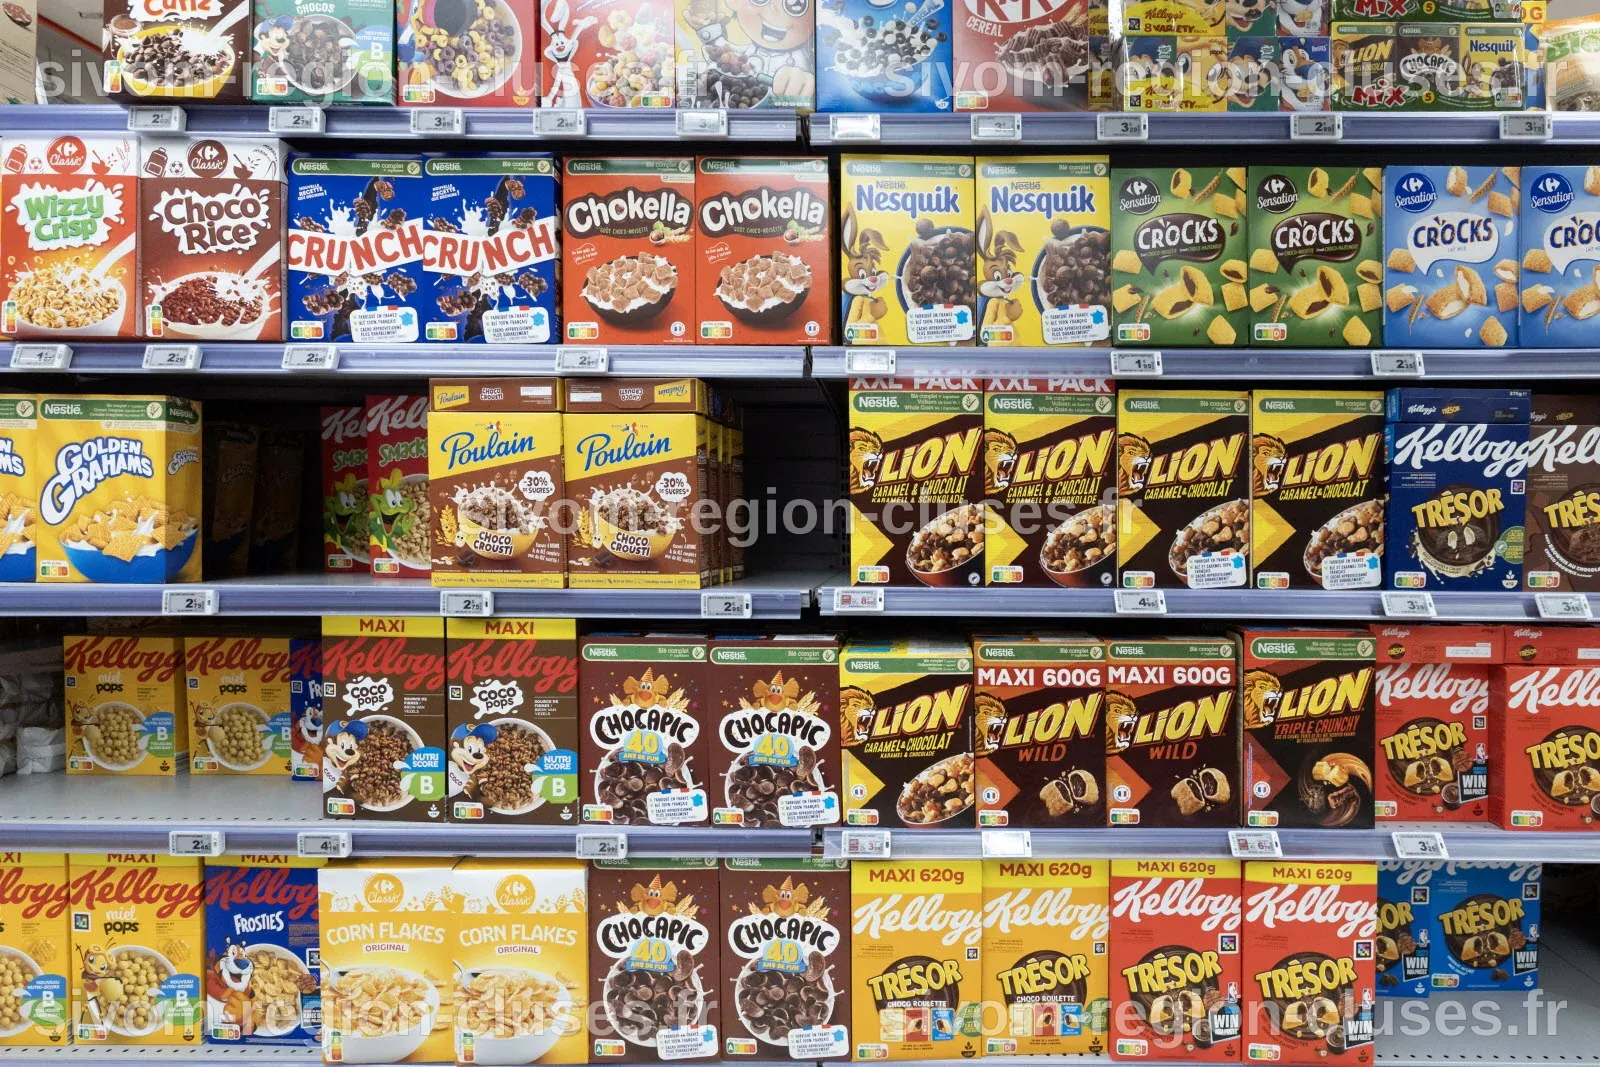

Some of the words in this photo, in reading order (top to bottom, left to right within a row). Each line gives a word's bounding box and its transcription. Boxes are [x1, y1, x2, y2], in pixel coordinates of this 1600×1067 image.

[296, 2, 335, 15] CHOCOS
[1425, 3, 1433, 13] 5
[965, 15, 1003, 37] CEREAL
[1144, 23, 1152, 32] 8
[1153, 23, 1195, 33] VARIETY
[1349, 40, 1394, 63] LION
[1469, 40, 1517, 55] Nesquik
[24, 194, 105, 220] Wizzy
[856, 184, 961, 219] Nesquik
[991, 185, 1096, 220] Nesquik
[1119, 194, 1161, 211] Sensation
[1256, 192, 1299, 210] Sensation
[1394, 191, 1437, 209] Sensation
[1530, 191, 1574, 209] Sensation
[164, 196, 261, 225] Choco
[568, 189, 690, 232] Chokella
[702, 189, 824, 232] Chokella
[35, 217, 98, 242] Crisp
[183, 221, 252, 252] Rice
[289, 224, 423, 274] CRUNCH
[423, 223, 554, 271] CRUNCH
[852, 370, 904, 390] XXL
[913, 370, 979, 390] PACK
[436, 391, 466, 405] Poulain
[479, 393, 504, 401] CROUSTI
[481, 387, 501, 395] CHOCO
[619, 388, 644, 396] CROUSTI
[45, 403, 83, 415] Nestlé
[859, 396, 900, 408] Nestlé
[1408, 405, 1437, 414] Kellogg's
[57, 437, 142, 480] GOLDEN
[440, 431, 536, 470] Poulain
[576, 433, 672, 472] Poulain
[878, 427, 982, 483] LION
[1013, 428, 1114, 483] LION
[1149, 433, 1243, 486] LION
[1284, 433, 1379, 486] LION
[1394, 423, 1531, 478] Kellogg
[41, 453, 154, 525] GRAHAMS
[523, 477, 548, 487] -30%
[873, 484, 908, 497] CARAMEL
[911, 485, 918, 495] &
[921, 476, 968, 495] CHOCOLAT
[1007, 484, 1042, 498] CARAMEL
[1045, 485, 1052, 495] &
[1055, 477, 1101, 496] CHOCOLAT
[1144, 486, 1182, 500] CARAMEL
[1187, 479, 1233, 498] CHOCOLAT
[917, 495, 964, 504] SCHOKOLADE
[1411, 488, 1505, 528] TRÉSOR
[478, 531, 512, 545] CHOCO
[615, 532, 649, 546] CHOCO
[473, 541, 514, 556] CROUSTI
[610, 541, 651, 557] CROUSTI
[359, 619, 406, 633] MAXI
[485, 621, 535, 635] MAXI
[65, 636, 186, 683] Kellogg
[589, 648, 619, 657] Nestlé
[323, 637, 445, 690] Kellogg
[449, 638, 579, 694] Kellogg
[977, 668, 1034, 686] MAXI
[1042, 668, 1101, 686] 600G
[1108, 666, 1165, 684] MAXI
[1173, 666, 1231, 685] 600G
[96, 684, 124, 695] pops
[219, 684, 247, 695] pops
[1278, 668, 1373, 720] LION
[357, 695, 385, 707] pops
[485, 698, 514, 710] pops
[872, 684, 969, 737] LION
[594, 708, 693, 745] CHOCAPIC
[1004, 692, 1103, 746] LION
[1136, 690, 1234, 744] LION
[1275, 721, 1314, 735] TRIPLE
[1314, 715, 1360, 733] CRUNCHY
[724, 712, 825, 747] CHOCAPIC
[628, 731, 659, 754] 40
[754, 734, 790, 757] 40
[1149, 741, 1198, 760] WILD
[1380, 722, 1467, 761] TRÉSOR
[412, 753, 439, 761] NUTRI
[543, 755, 571, 763] NUTRI
[647, 754, 660, 762] FUN
[1017, 744, 1066, 762] WILD
[412, 760, 439, 768] SCORE
[543, 762, 571, 770] SCORE
[420, 776, 434, 795] B
[552, 778, 566, 797] B
[1462, 774, 1487, 788] WIN
[869, 869, 916, 882] MAXI
[919, 868, 965, 885] 620g
[999, 863, 1045, 876] MAXI
[1048, 862, 1092, 879] 620g
[1137, 861, 1175, 873] MAXI
[1179, 861, 1216, 875] 620g
[1272, 867, 1311, 879] MAXI
[1316, 867, 1353, 882] 620g
[70, 867, 205, 919] Kellogg
[106, 907, 135, 921] miel
[233, 910, 285, 935] FROSTIES
[853, 894, 982, 946] Kellogg
[983, 888, 1110, 940] Kellogg
[1438, 898, 1526, 935] TRÉSOR
[326, 923, 374, 945] CORN
[378, 921, 446, 945] FLAKES
[459, 925, 507, 947] CORN
[511, 924, 578, 947] FLAKES
[601, 916, 703, 953] CHOCAPIC
[733, 917, 834, 954] CHOCAPIC
[365, 944, 407, 952] ORIGINAL
[497, 946, 538, 954] ORIGINAL
[868, 960, 963, 1000] TRÉSOR
[997, 954, 1091, 995] TRÉSOR
[1123, 951, 1223, 993] TRÉSOR
[1256, 957, 1358, 999] TRÉSOR
[912, 1000, 947, 1008] ROULETTE
[1042, 995, 1075, 1003] ROULETTE
[1214, 1013, 1238, 1029] WIN
